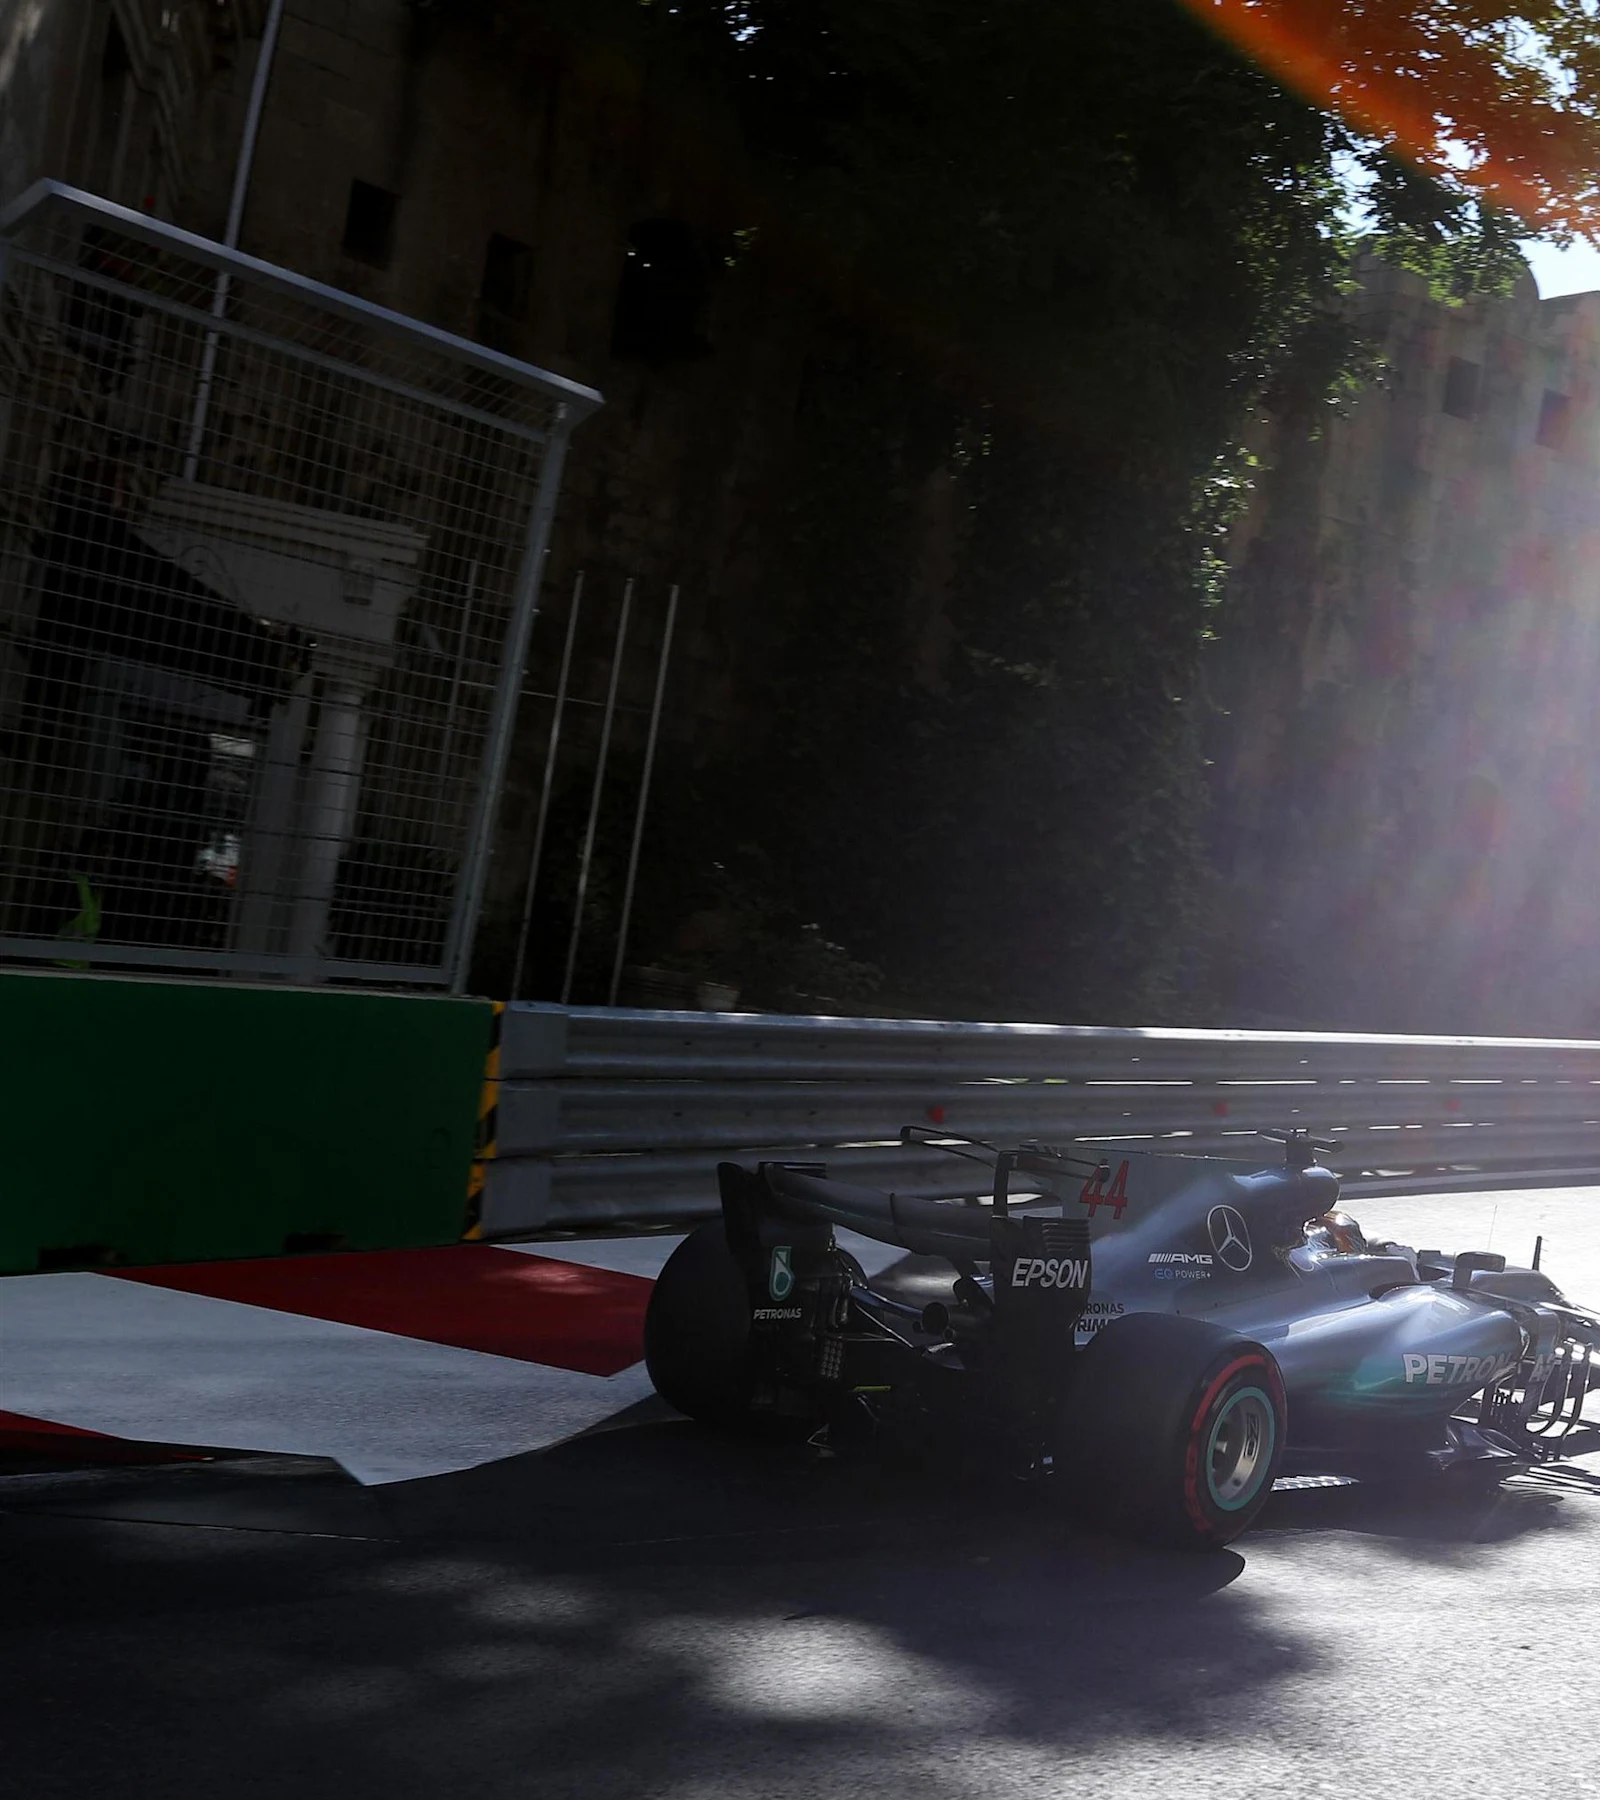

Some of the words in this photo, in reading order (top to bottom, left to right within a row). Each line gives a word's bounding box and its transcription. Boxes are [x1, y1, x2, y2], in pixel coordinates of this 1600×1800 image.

[1079, 1160, 1128, 1219] 44
[1170, 1253, 1213, 1264] AMG
[1011, 1257, 1088, 1289] EPSON
[753, 1308, 802, 1320] PETRONAS
[1085, 1302, 1125, 1314] RONAS
